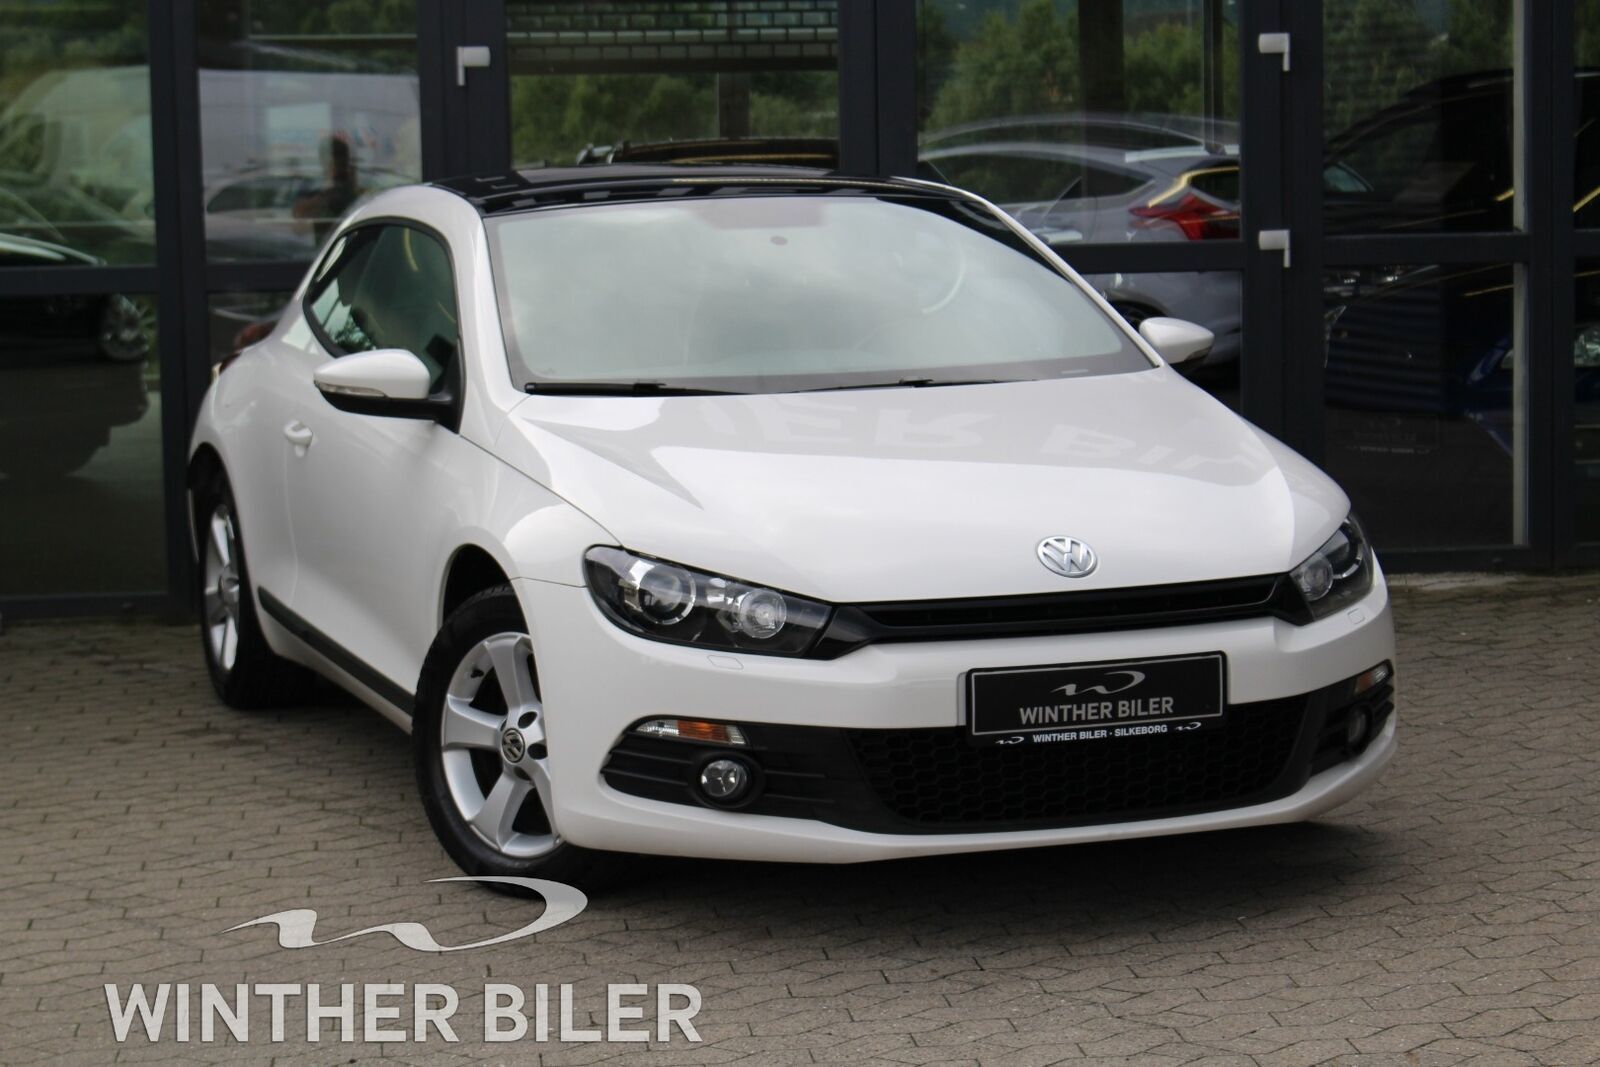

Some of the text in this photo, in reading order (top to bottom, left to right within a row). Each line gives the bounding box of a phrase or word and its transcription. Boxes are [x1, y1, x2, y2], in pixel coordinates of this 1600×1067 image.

[1019, 697, 1174, 725] WINTHER BILER
[1033, 725, 1168, 743] WINTHER BILER SILKEBORG
